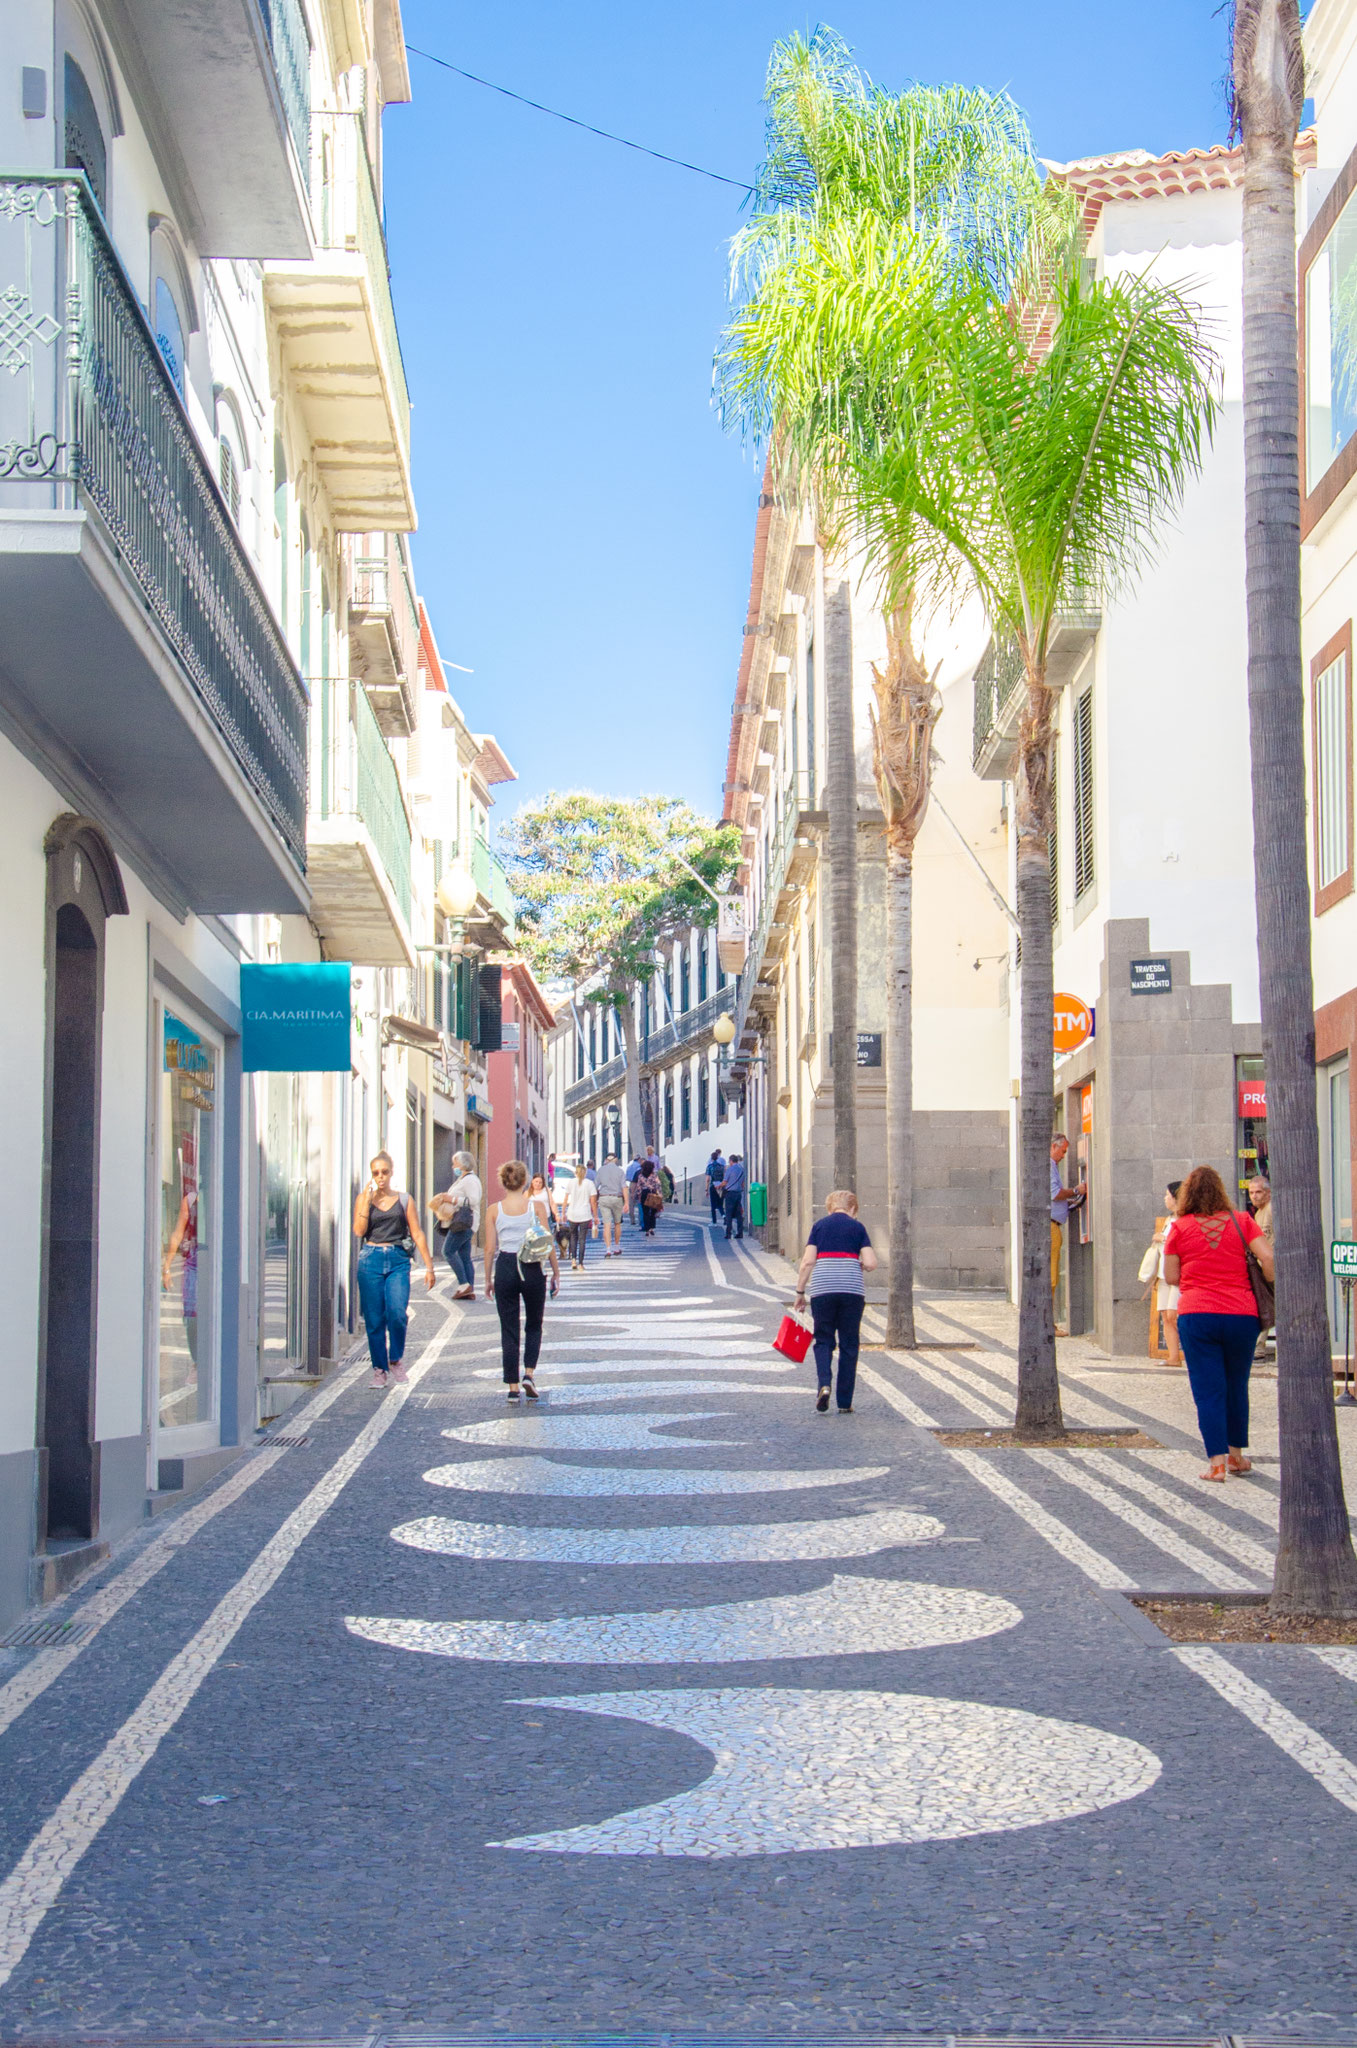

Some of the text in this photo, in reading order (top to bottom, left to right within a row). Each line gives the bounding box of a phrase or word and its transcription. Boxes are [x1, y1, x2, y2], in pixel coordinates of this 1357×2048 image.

[1134, 964, 1166, 973] TRAVESSA
[1131, 980, 1170, 989] NASCIMENTO
[1053, 1011, 1087, 1031] TM
